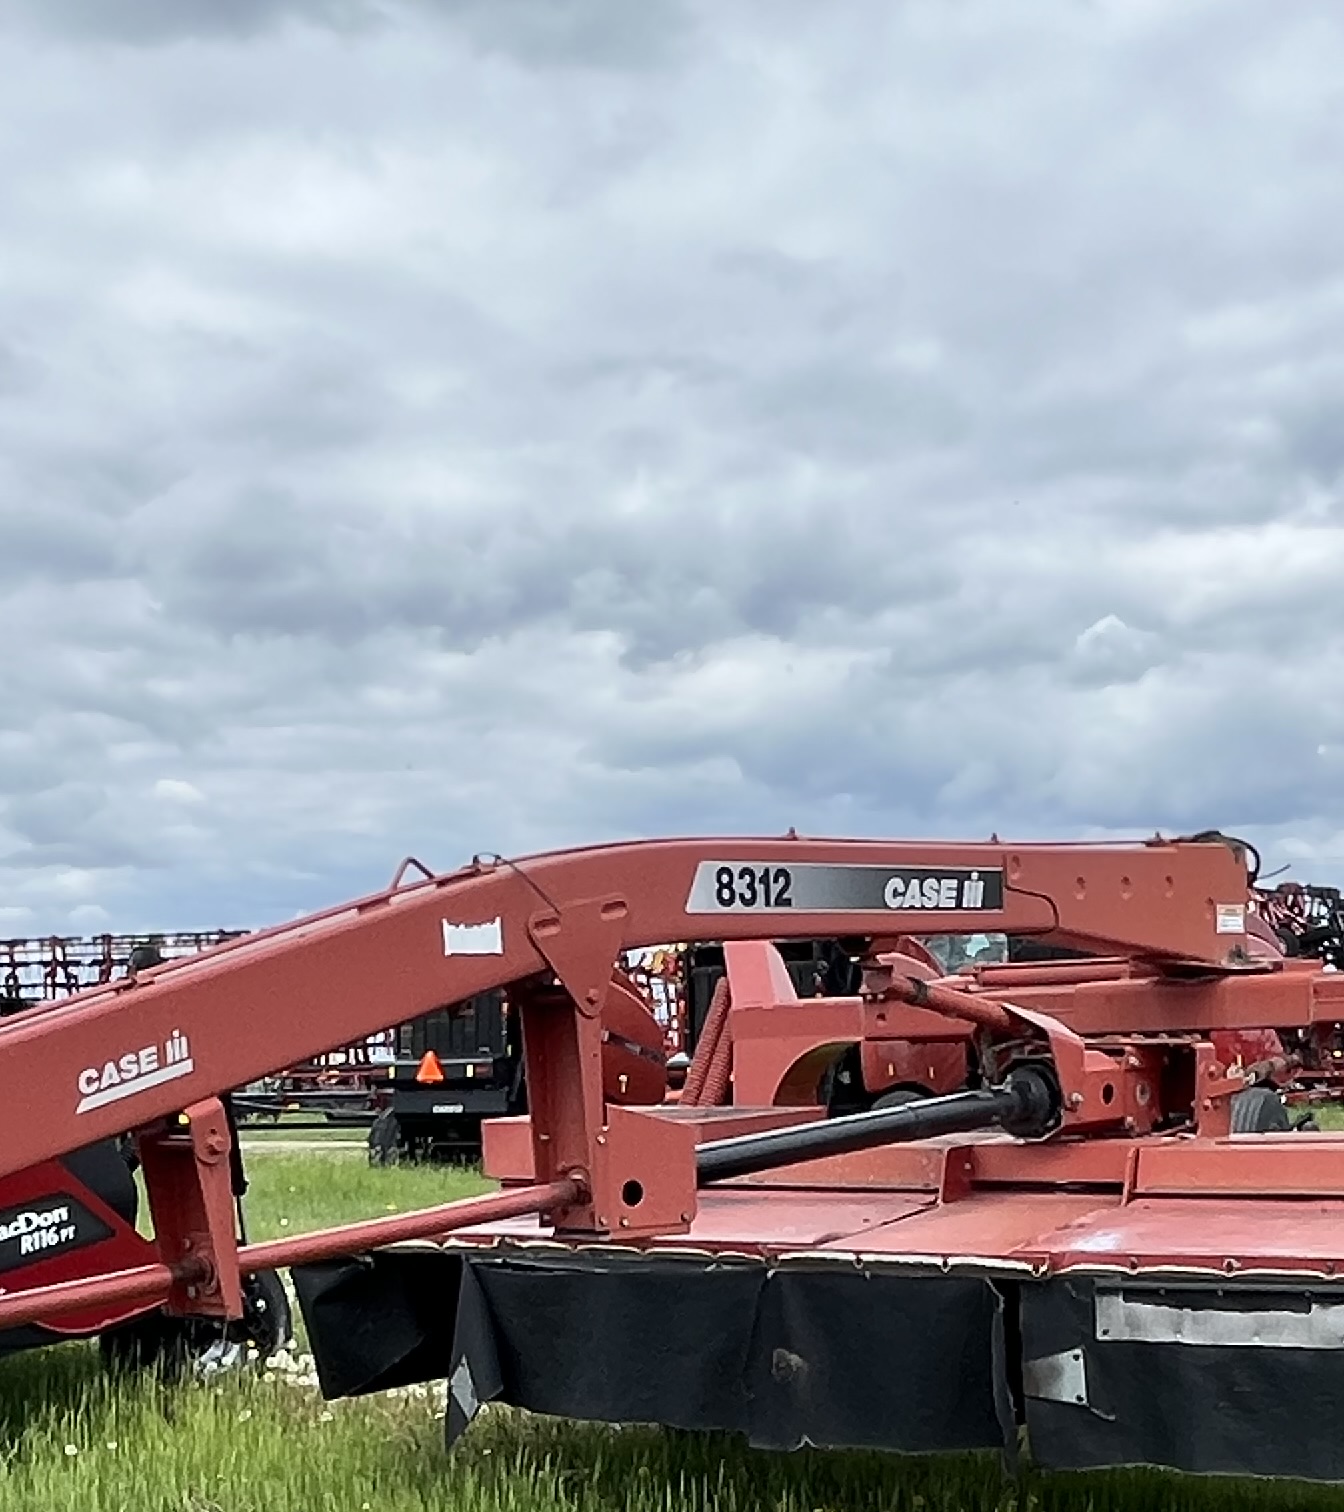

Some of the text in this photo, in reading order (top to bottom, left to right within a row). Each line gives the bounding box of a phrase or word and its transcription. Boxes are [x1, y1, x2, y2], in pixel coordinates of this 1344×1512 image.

[716, 866, 793, 908] 8312
[884, 877, 957, 908] CASE
[78, 1045, 159, 1094] CASE
[20, 1226, 59, 1255] R116
